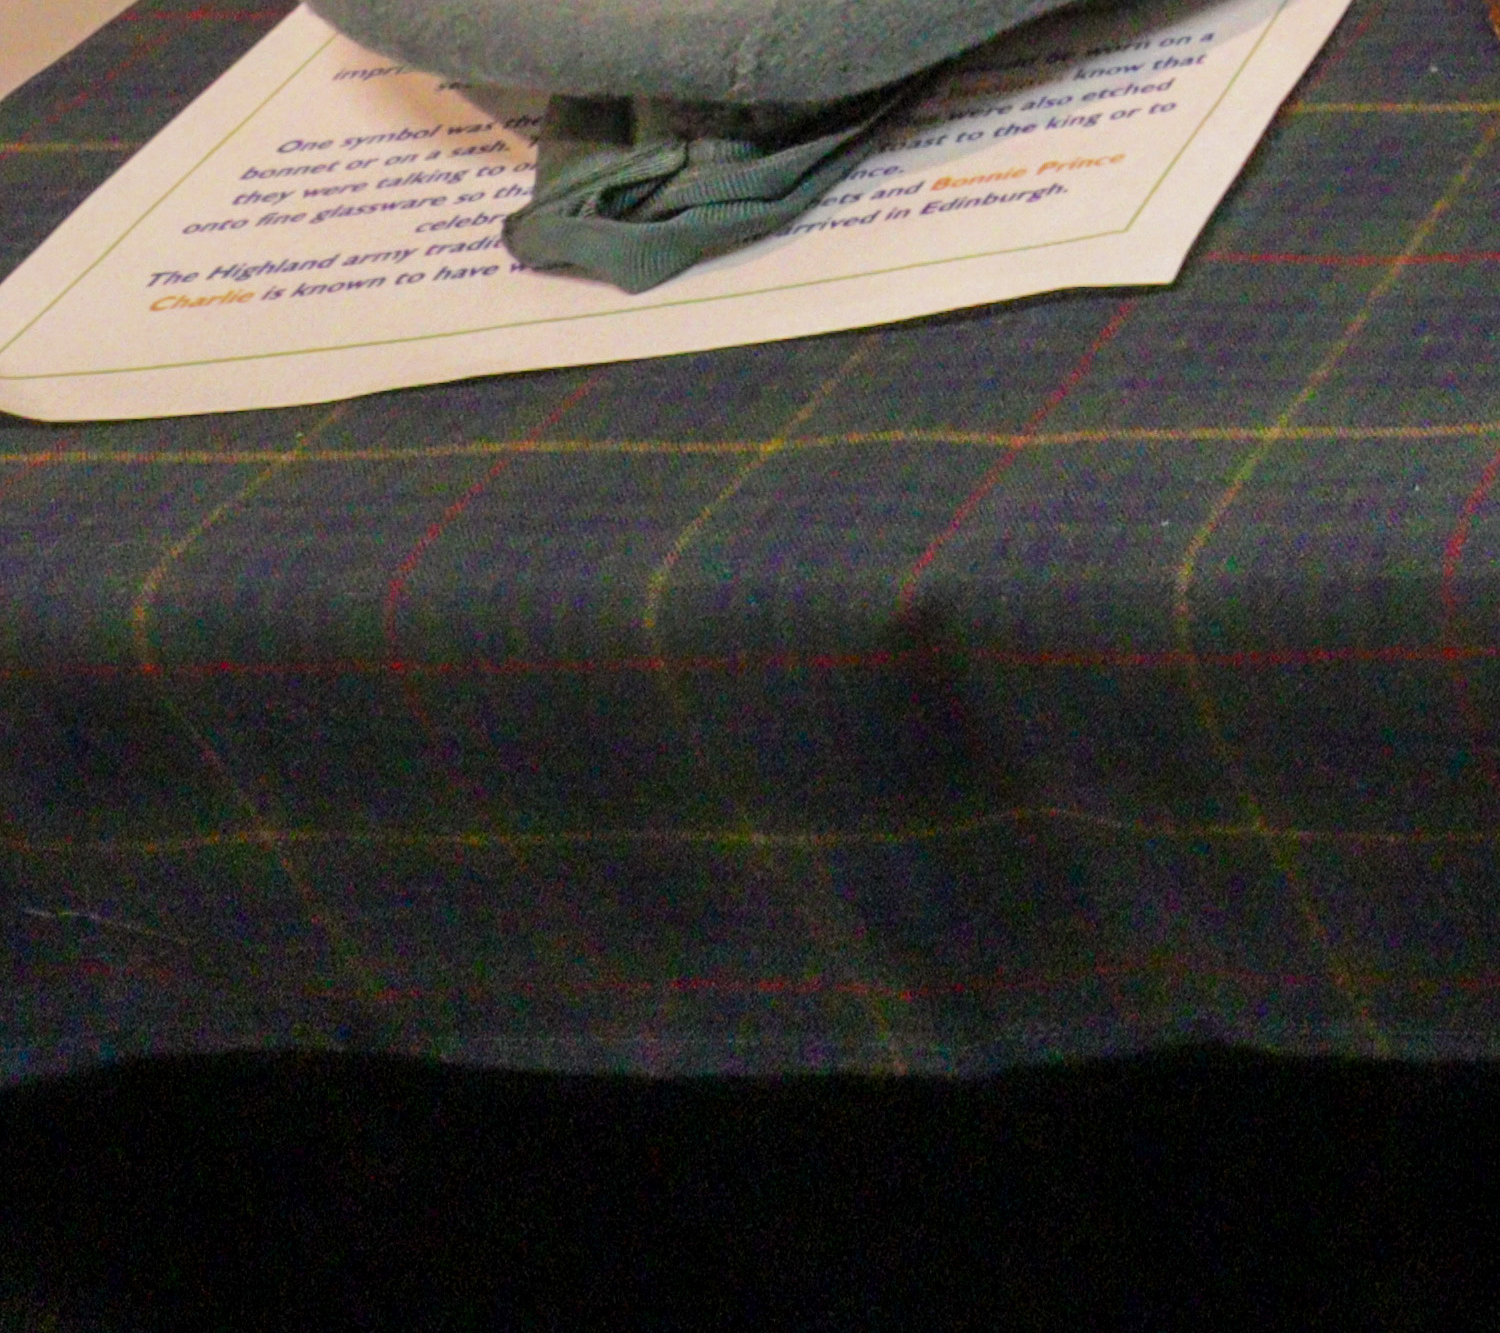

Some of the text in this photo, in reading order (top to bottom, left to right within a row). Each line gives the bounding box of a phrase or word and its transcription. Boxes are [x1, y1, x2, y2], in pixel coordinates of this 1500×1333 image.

[232, 77, 1176, 210] they were talking to were also etched
[238, 159, 339, 181] bonnet
[346, 156, 377, 171] or
[384, 150, 419, 167] on
[425, 149, 441, 161] a
[451, 140, 511, 158] sash.
[1073, 59, 1145, 80] know
[1152, 53, 1207, 71] that
[276, 139, 331, 154] One
[340, 125, 441, 150] symbol
[447, 120, 494, 135] was
[1159, 34, 1192, 48] on
[1200, 32, 1215, 43] a
[146, 152, 1126, 288] The Highland army and Bonnie Prince
[182, 218, 249, 235] onto
[256, 210, 306, 227] fine
[309, 193, 447, 225] glassware
[453, 190, 486, 206] so
[955, 129, 985, 144] to
[993, 120, 1037, 140] the
[1044, 111, 1101, 132] king
[1110, 106, 1143, 122] or
[1149, 100, 1177, 114] to
[149, 289, 255, 312] Charlie
[261, 285, 285, 301] is
[290, 274, 387, 297] known
[394, 272, 424, 286] to
[433, 261, 500, 281] have
[885, 207, 911, 221] in
[919, 183, 1069, 216] Edinburgh.
